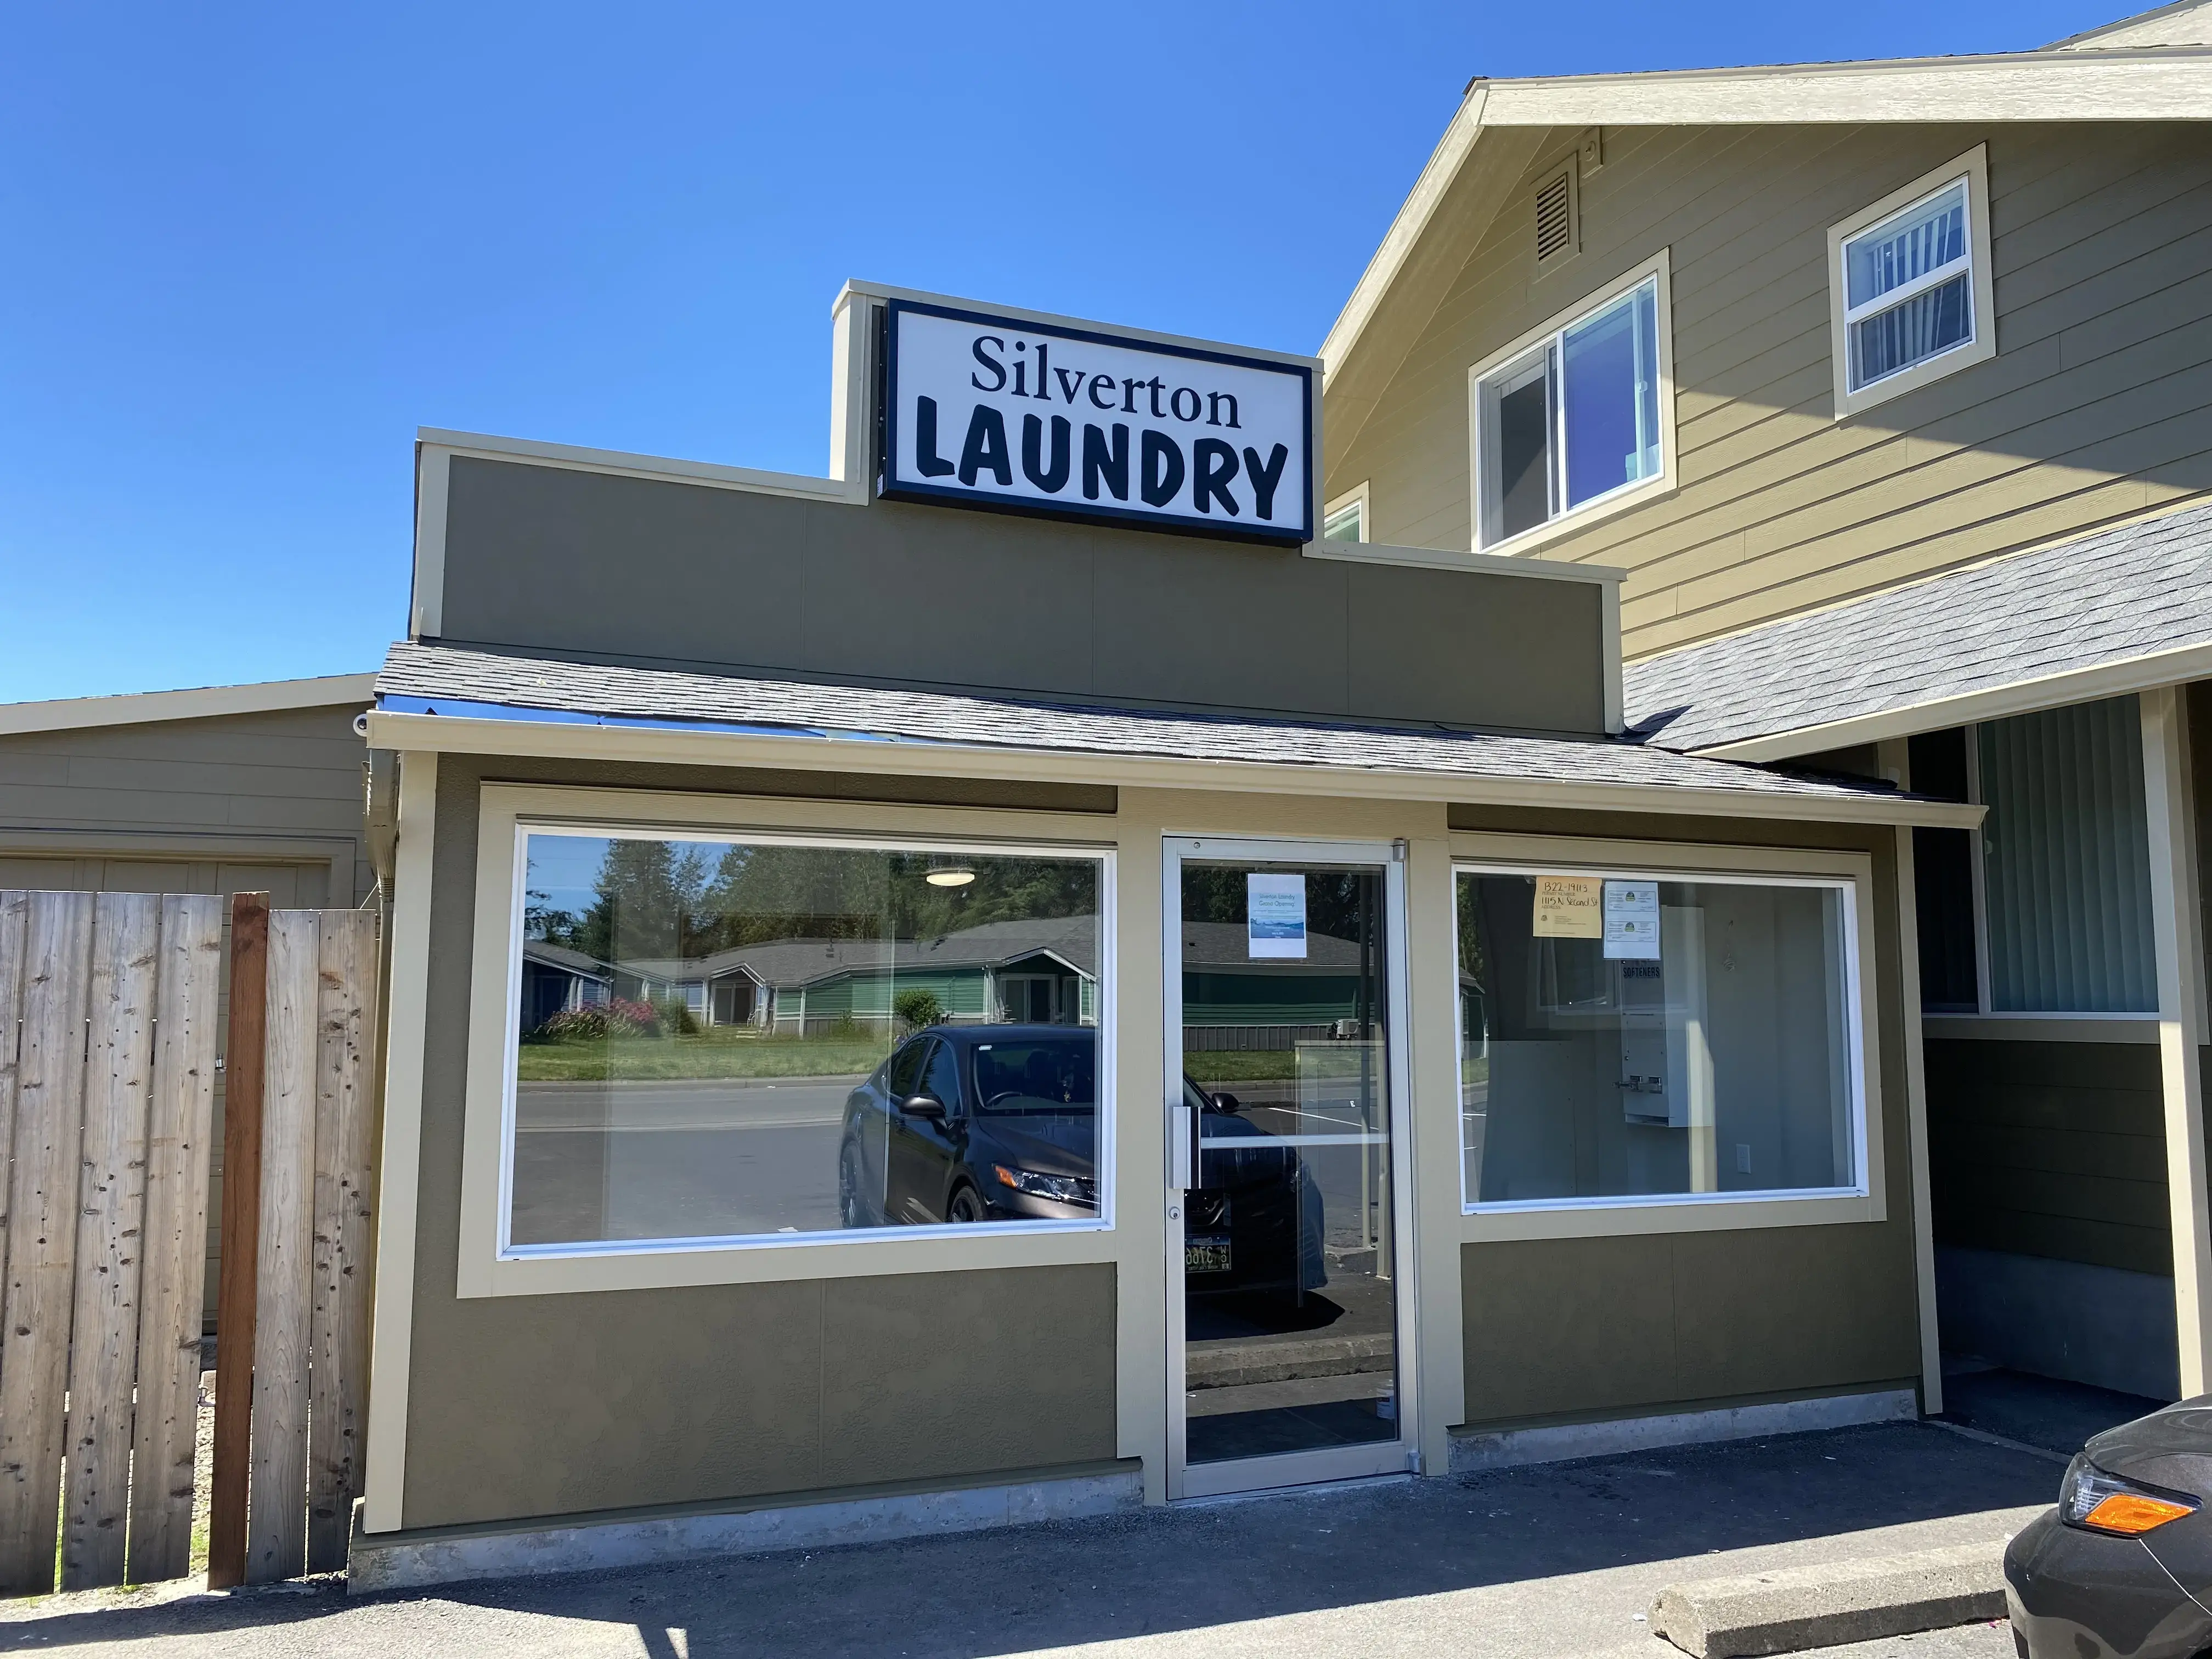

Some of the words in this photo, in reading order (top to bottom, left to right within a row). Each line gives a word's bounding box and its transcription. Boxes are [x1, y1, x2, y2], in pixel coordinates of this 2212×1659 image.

[971, 336, 1241, 429] Silverton
[916, 395, 1288, 520] LAUNDRY
[1544, 882, 1588, 893] B22-19113
[1542, 897, 1556, 905] 1115
[1566, 896, 1589, 906] Second
[1590, 897, 1598, 906] St
[1623, 967, 1661, 978] SOFTENERS
